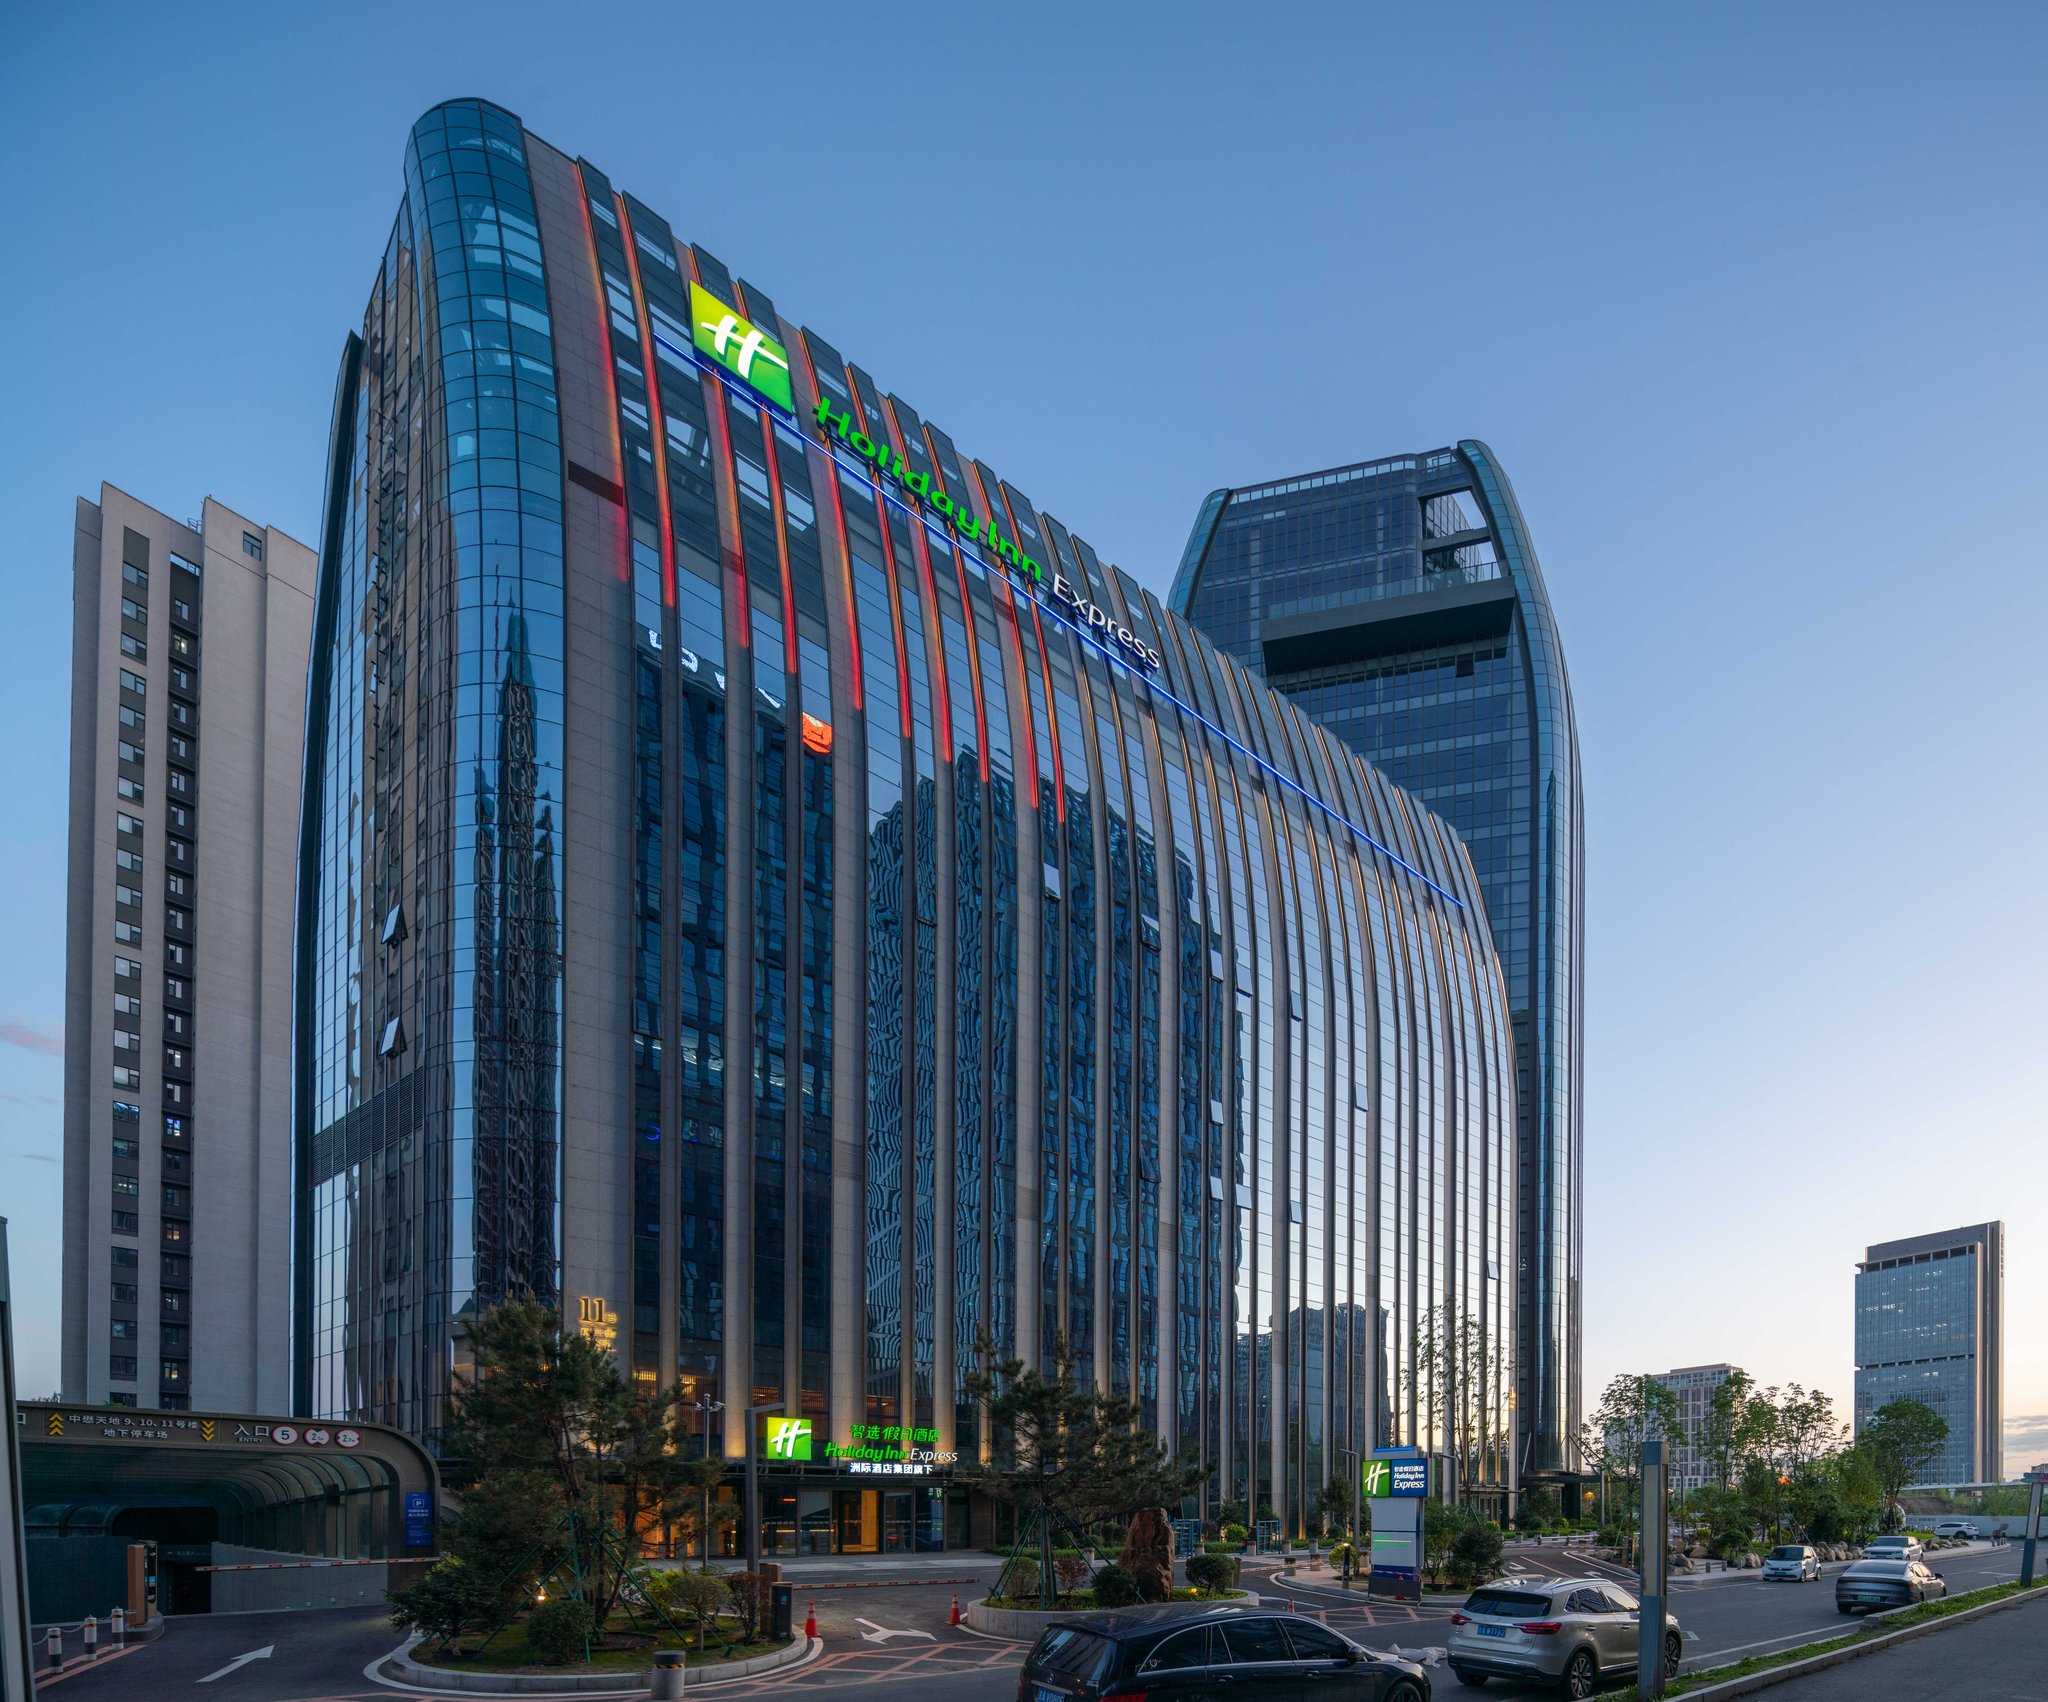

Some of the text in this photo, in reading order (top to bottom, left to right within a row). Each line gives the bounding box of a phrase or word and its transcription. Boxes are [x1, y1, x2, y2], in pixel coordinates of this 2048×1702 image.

[812, 396, 1161, 670] Holiday Inn Express
[104, 1428, 168, 1439] 地下停车场
[233, 1423, 270, 1437] 入口
[281, 1429, 290, 1441] 5
[850, 1423, 941, 1442] 智选假日酒店
[824, 1441, 959, 1463] Holiday Inn Express
[849, 1462, 934, 1475] 洲际酒店集团旗下
[1394, 1479, 1424, 1490] Express
